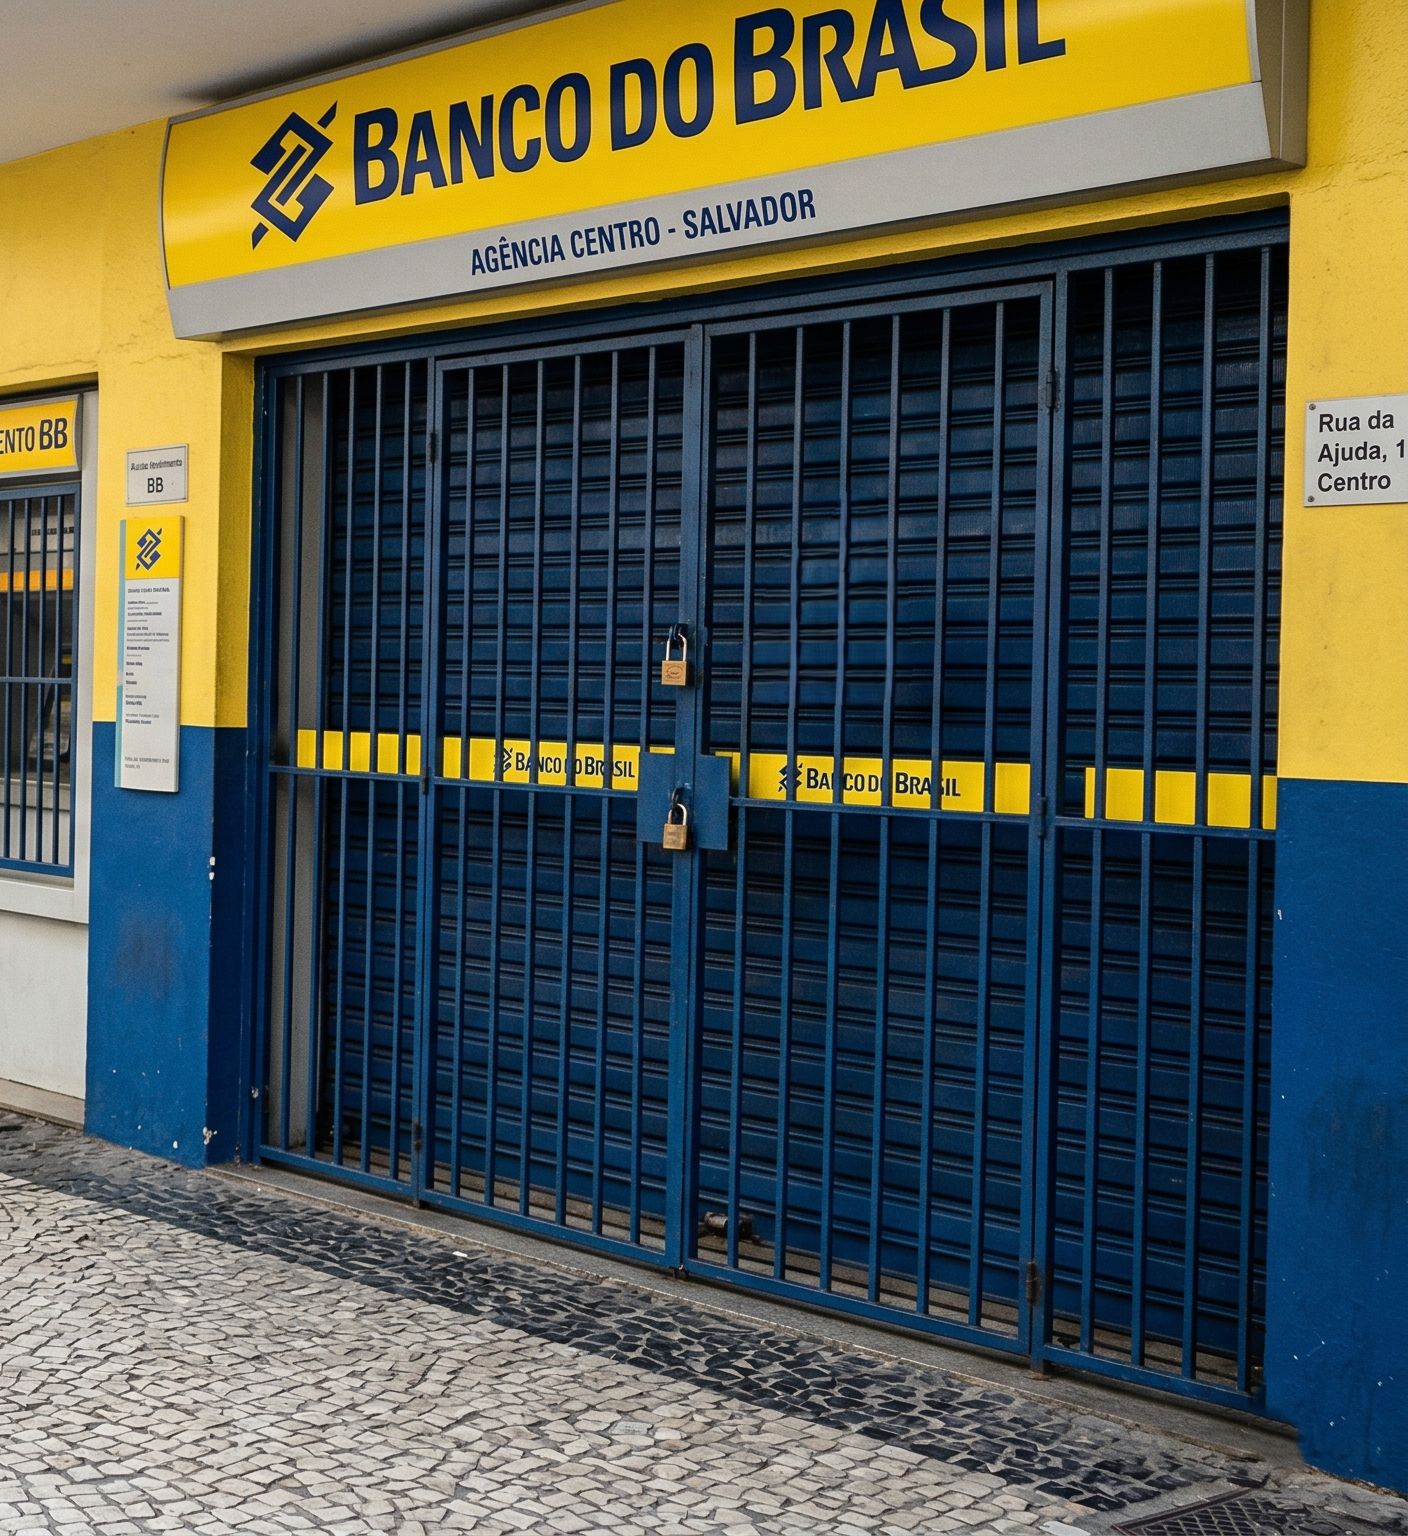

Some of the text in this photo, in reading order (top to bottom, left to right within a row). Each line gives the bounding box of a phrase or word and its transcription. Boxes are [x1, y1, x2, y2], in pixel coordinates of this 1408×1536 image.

[353, 0, 1067, 206] BANCO DO BRASIL
[471, 188, 817, 276] AGÊNCIA CENTRO - SALVADOR
[39, 417, 68, 450] BB
[1318, 410, 1395, 433] Rua da
[1317, 439, 1405, 467] Ajuda, 1
[147, 477, 164, 494] BB
[1317, 472, 1392, 493] Centro
[584, 756, 636, 778] BRSIL
[806, 767, 865, 792] BACO
[868, 774, 883, 793] D
